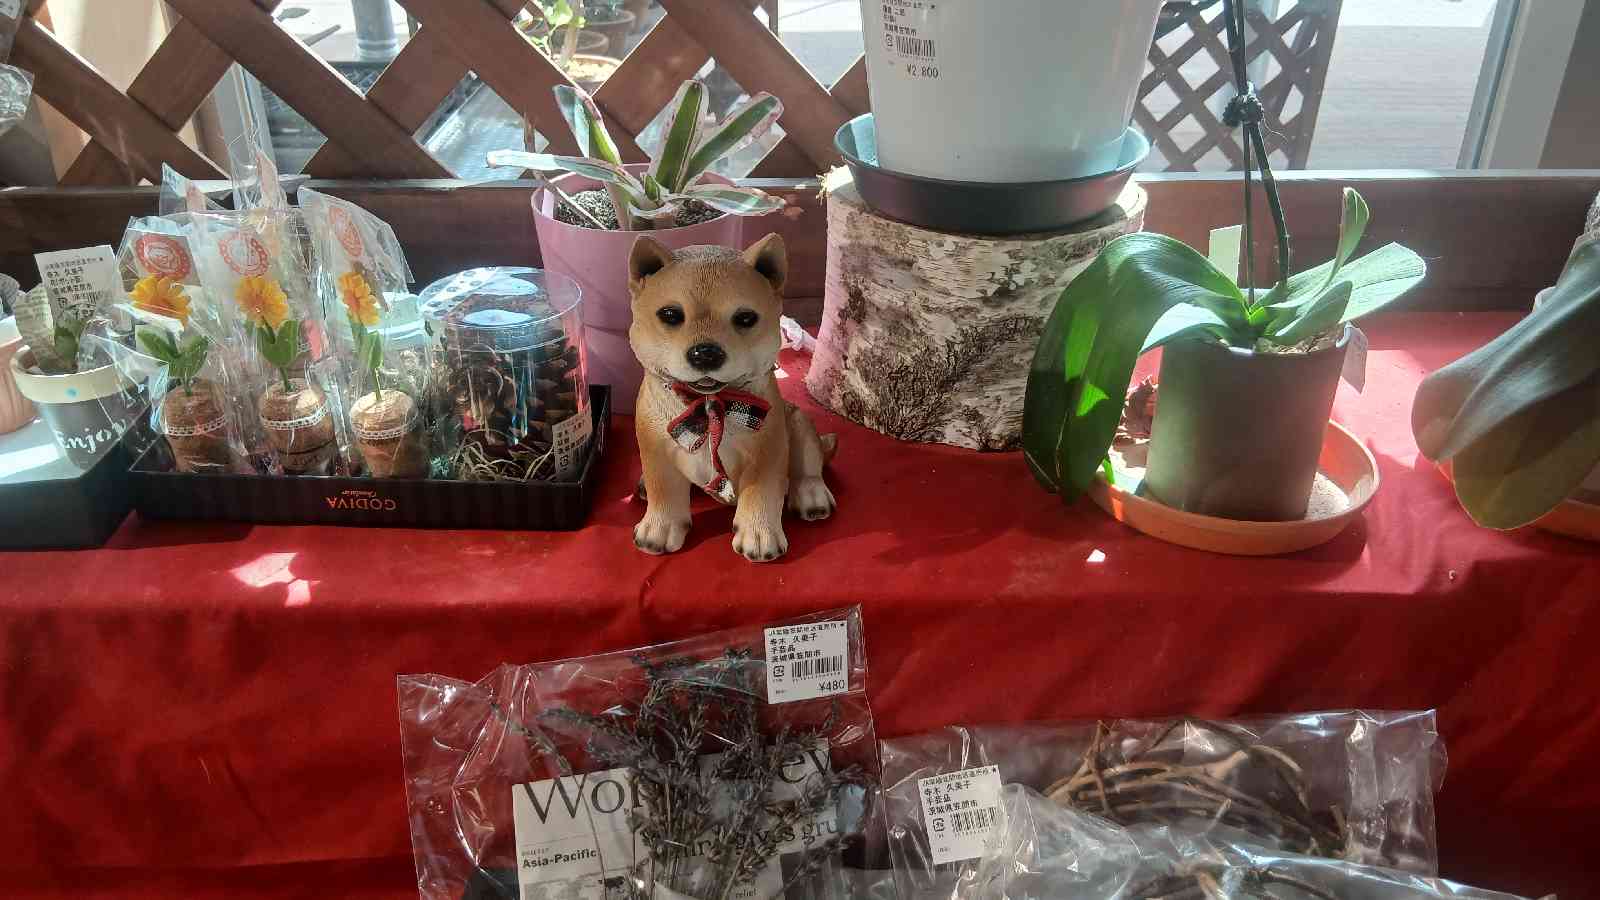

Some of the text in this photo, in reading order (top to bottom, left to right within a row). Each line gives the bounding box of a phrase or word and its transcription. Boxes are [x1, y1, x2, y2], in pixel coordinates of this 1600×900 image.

[54, 419, 127, 454] Enjoy
[325, 497, 396, 511] GODIVA
[819, 680, 845, 692] ¥480
[522, 848, 597, 869] Asia-Pacific
